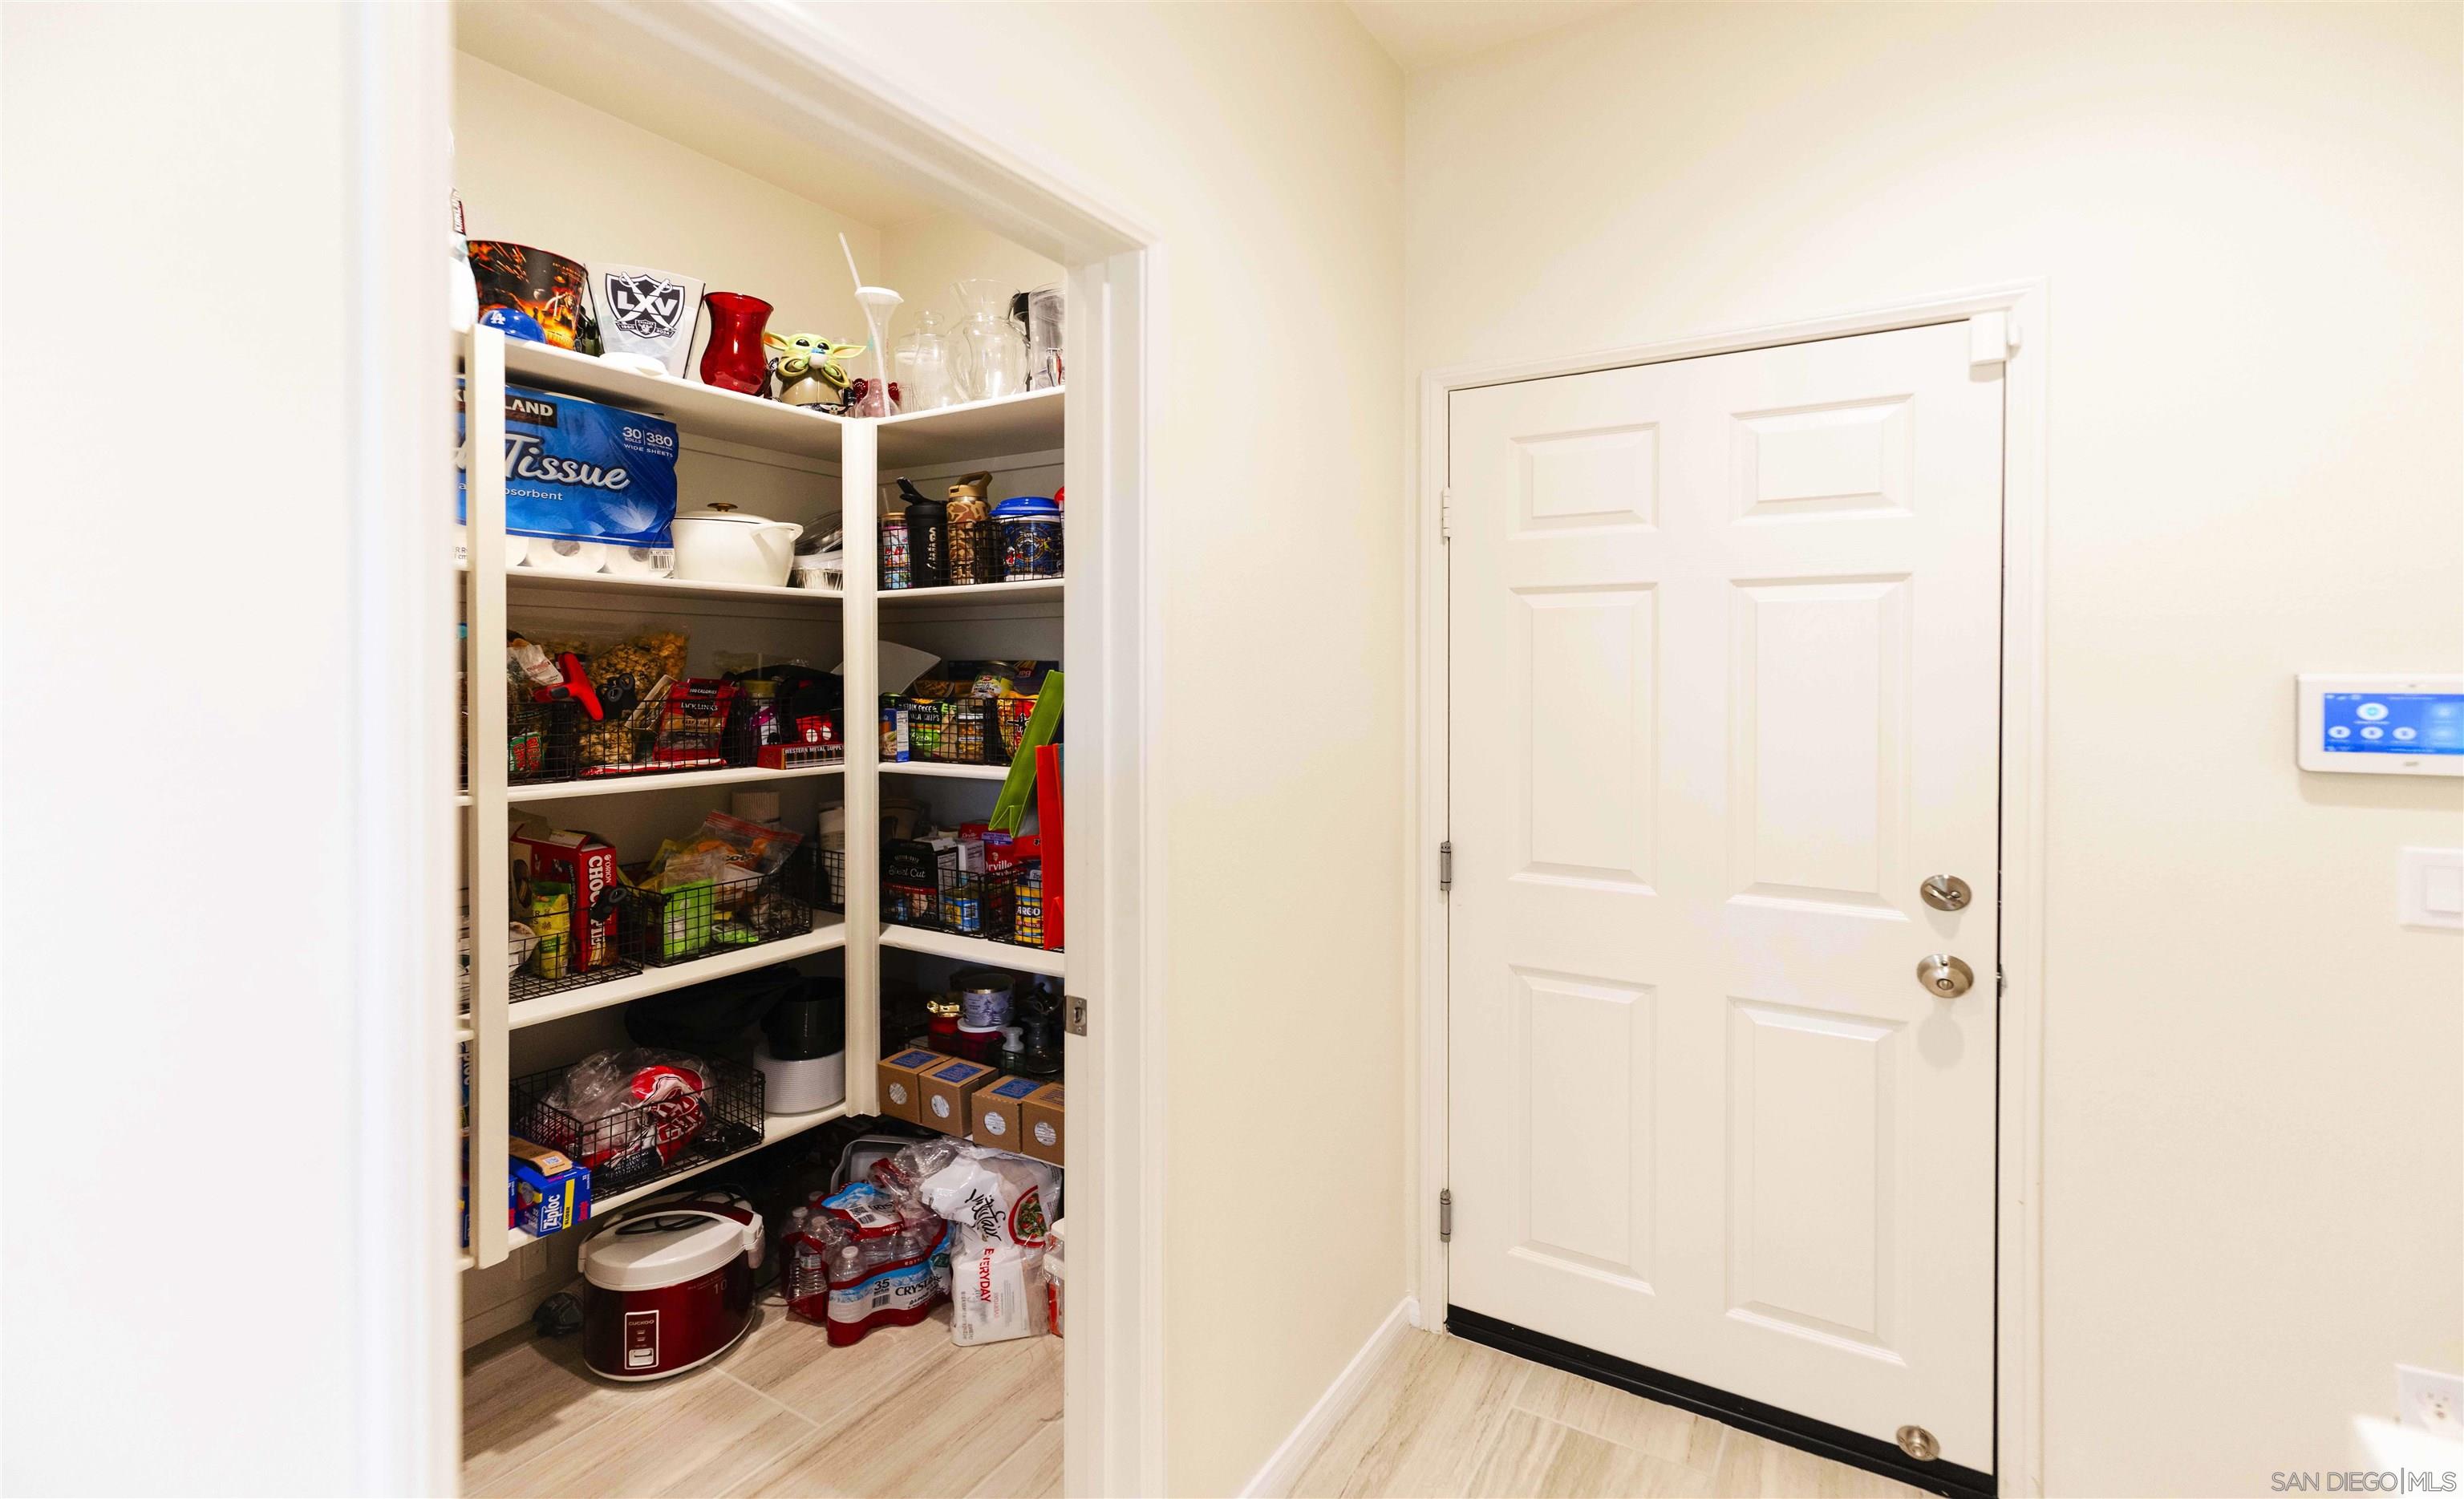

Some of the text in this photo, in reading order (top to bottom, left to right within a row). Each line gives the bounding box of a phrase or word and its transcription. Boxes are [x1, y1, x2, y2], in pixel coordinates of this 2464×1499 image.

[616, 289, 679, 317] LXV
[622, 427, 642, 439] 30
[646, 432, 673, 447] 380
[624, 444, 644, 452] WIDE
[646, 448, 674, 458] SHEETS
[505, 433, 630, 490] Tissue
[588, 855, 605, 905] CHOC
[543, 1193, 562, 1230] Ziploc
[873, 1278, 890, 1290] 35
